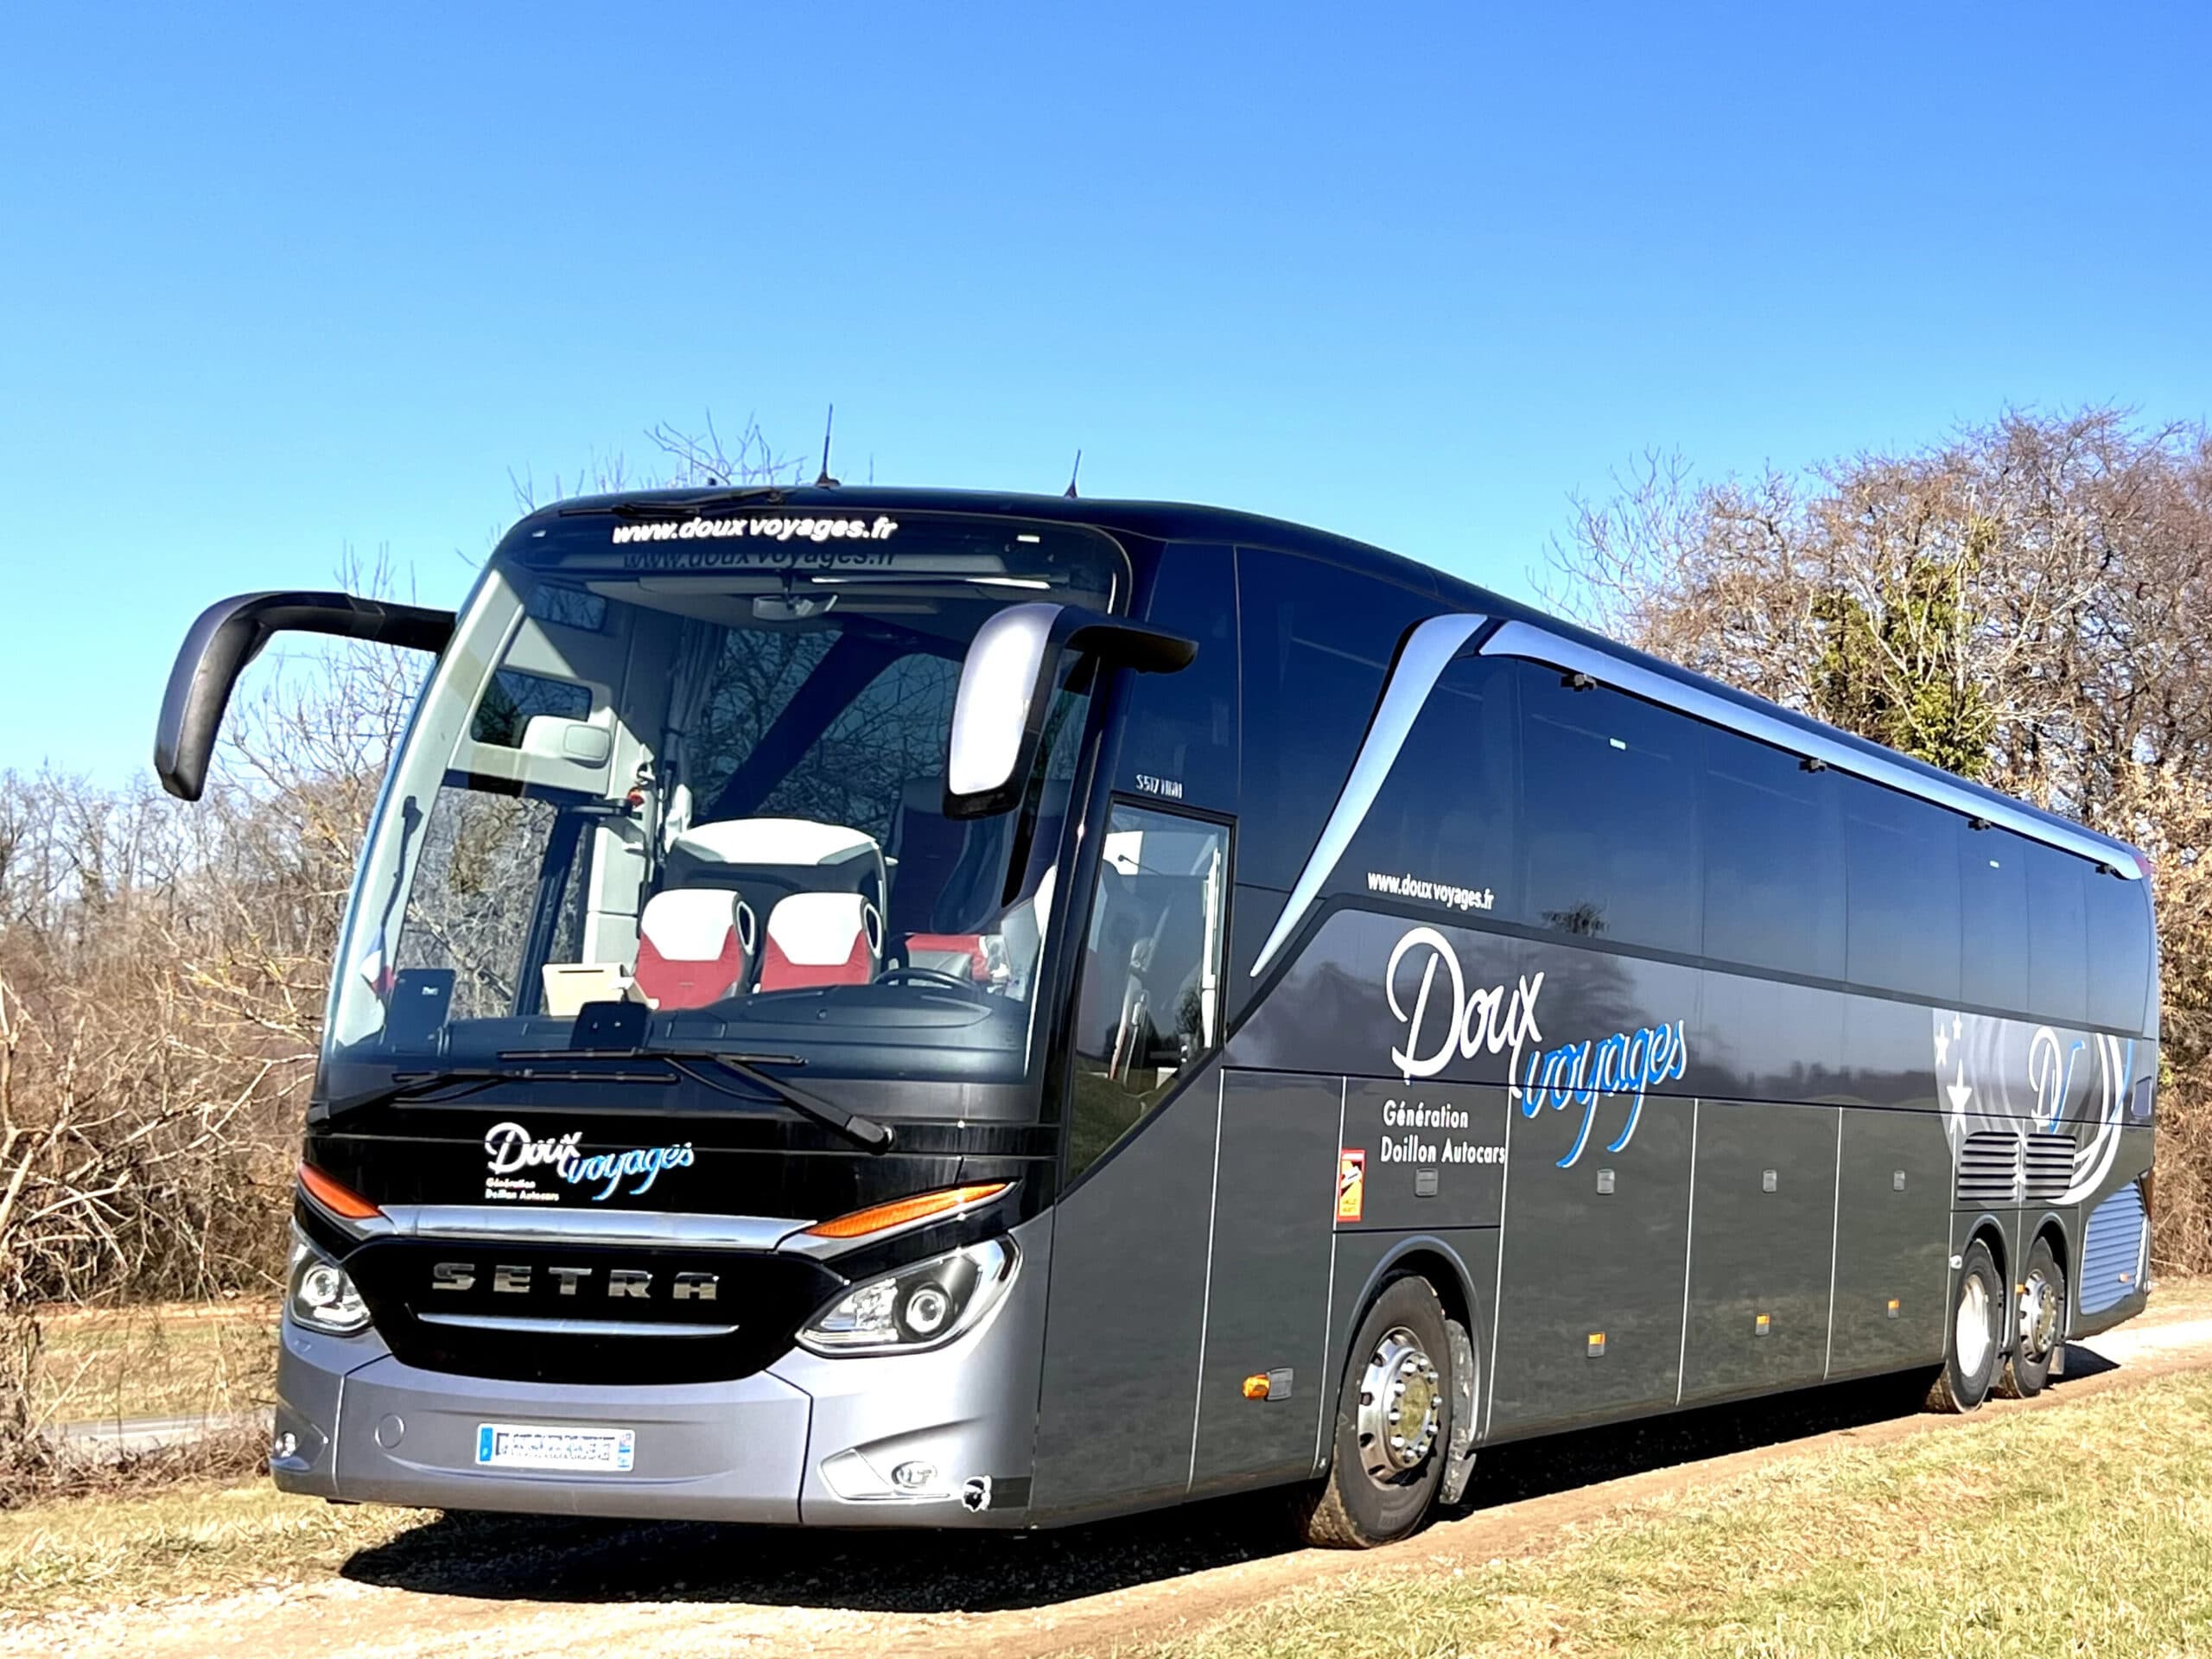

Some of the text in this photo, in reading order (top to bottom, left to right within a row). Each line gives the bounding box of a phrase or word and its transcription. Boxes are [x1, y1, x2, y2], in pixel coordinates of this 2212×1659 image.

[1386, 926, 1688, 1168] Doux voyages
[1382, 1099, 1469, 1128] Génération
[485, 1122, 695, 1201] Doux voyages
[1381, 1135, 1506, 1165] Doillon Autocars
[432, 1262, 720, 1300] SETRA
